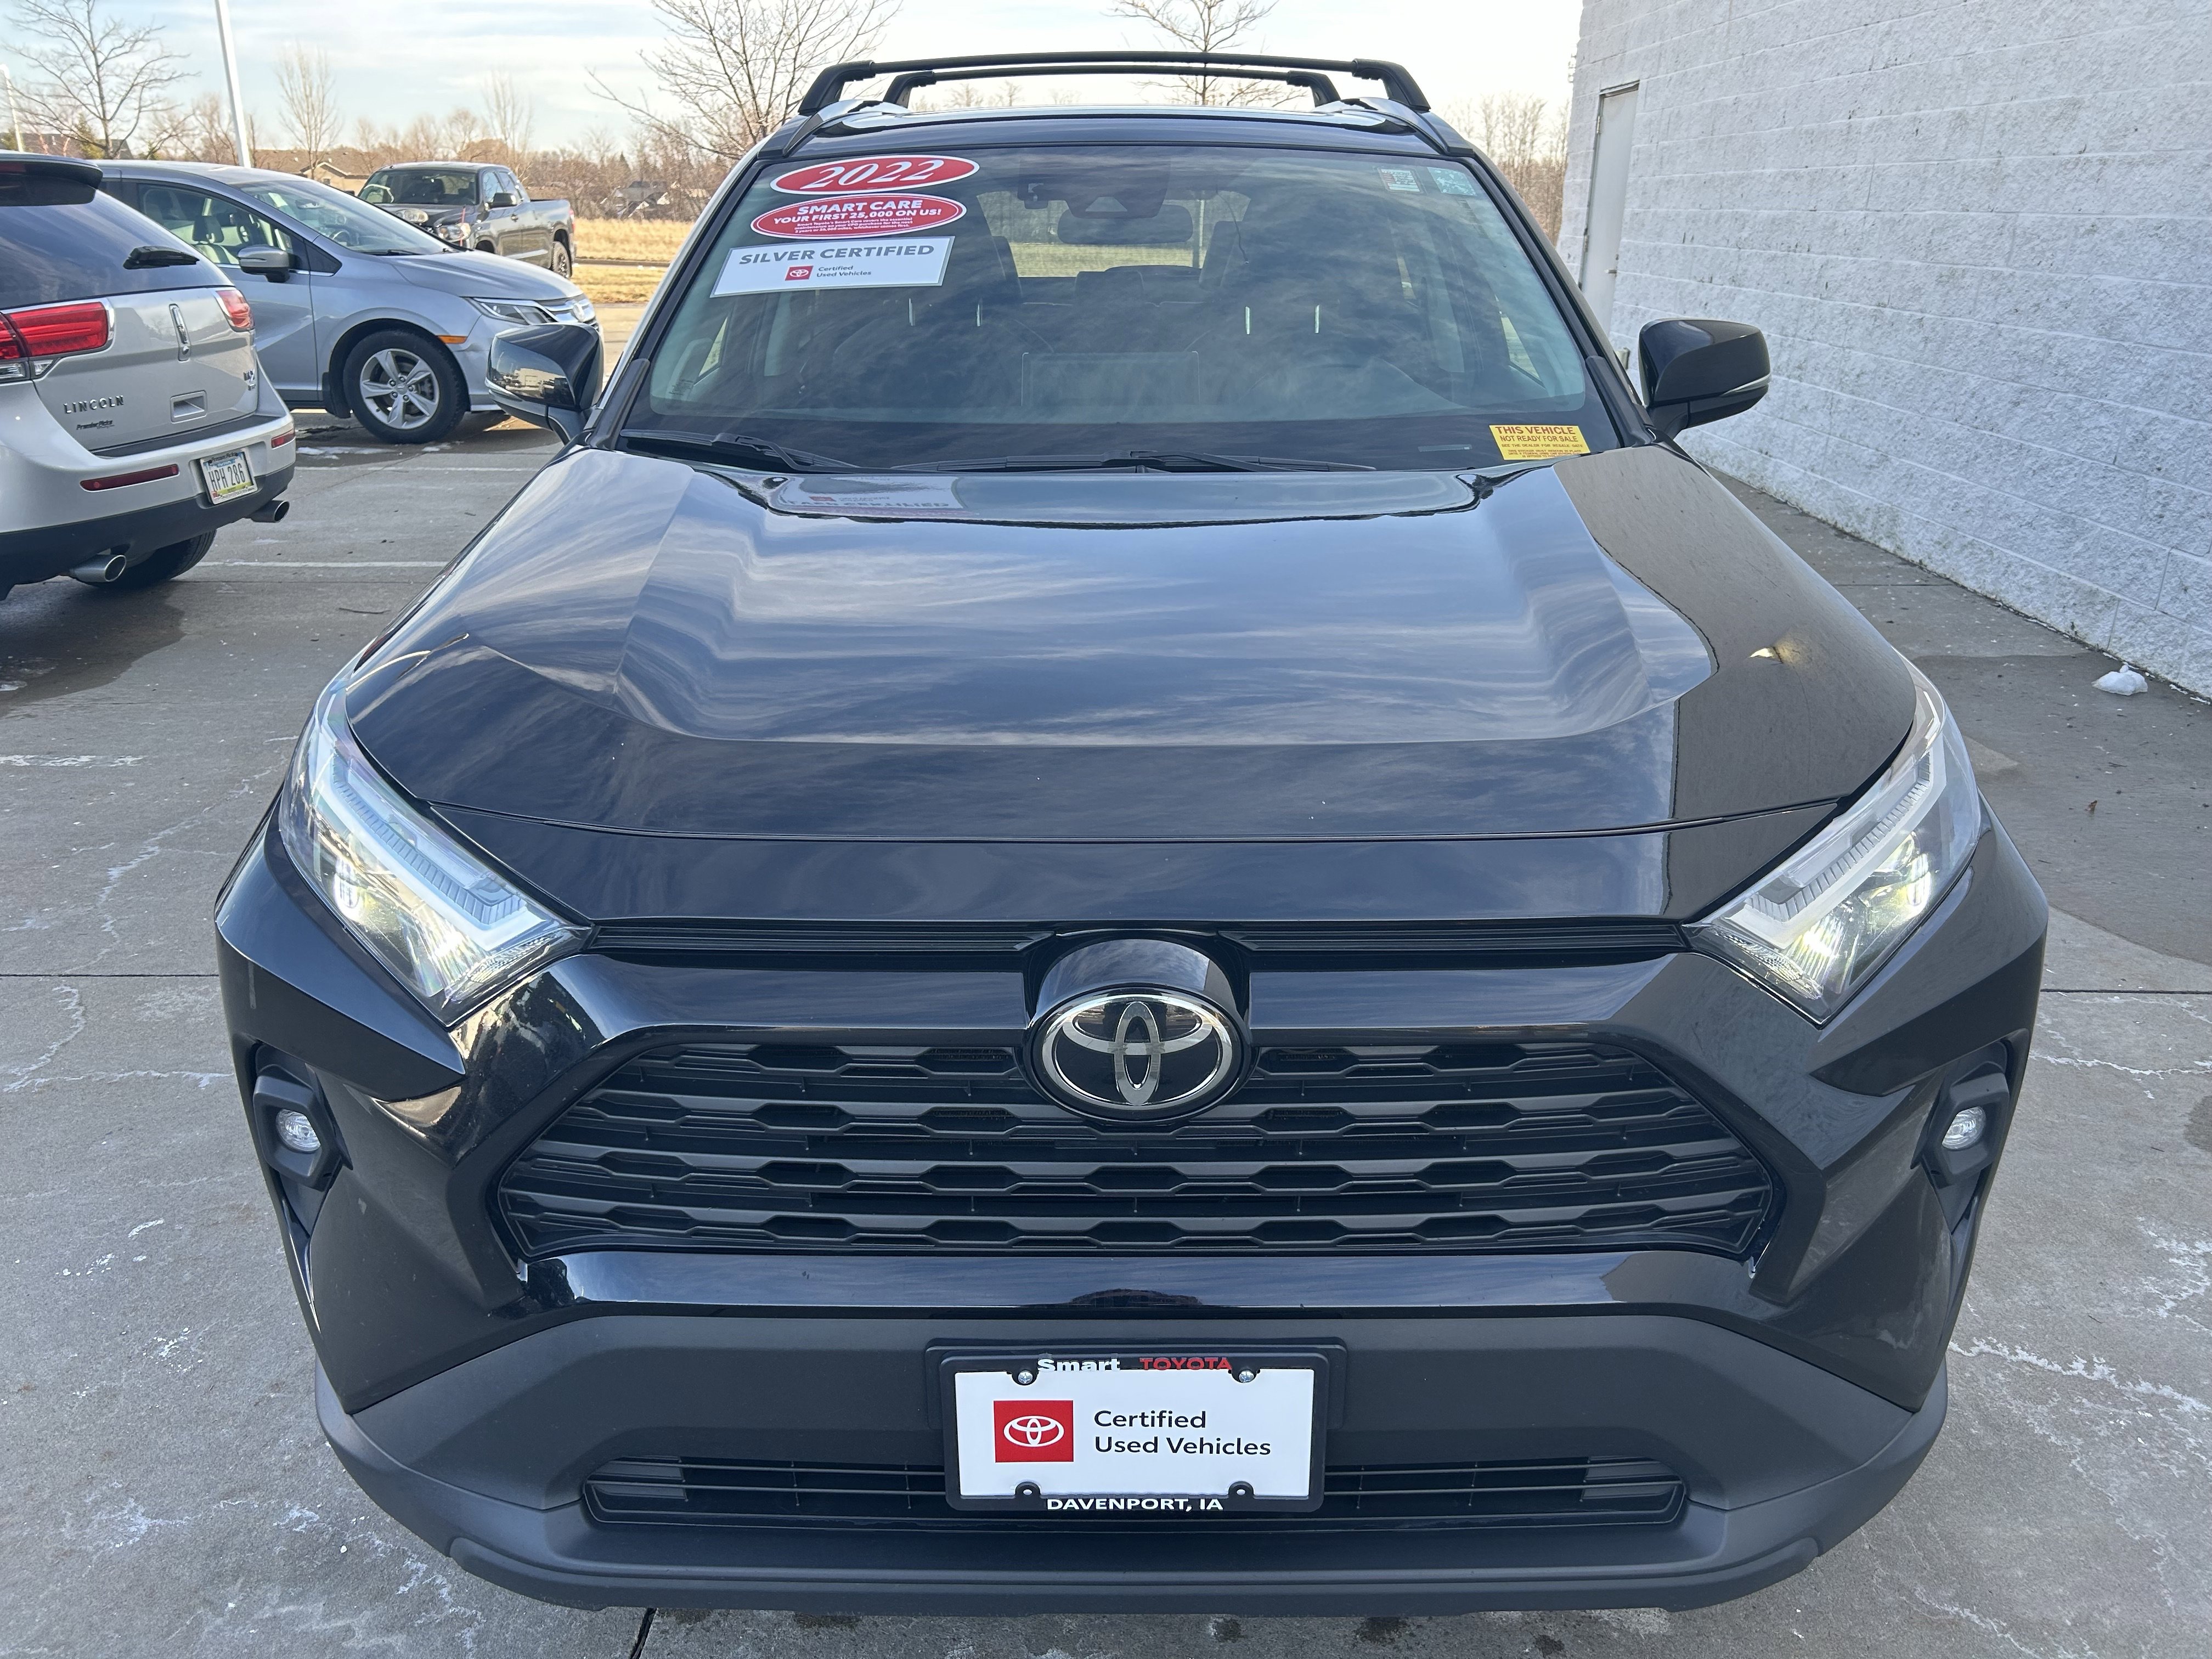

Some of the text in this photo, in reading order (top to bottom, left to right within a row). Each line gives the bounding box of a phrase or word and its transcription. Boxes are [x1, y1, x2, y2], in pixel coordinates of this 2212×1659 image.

[799, 160, 944, 189] 2022
[797, 200, 923, 215] SMART CARE
[774, 216, 810, 224] YOUR
[812, 213, 848, 221] FIRST
[849, 210, 893, 219] 25,000
[739, 245, 934, 264] SILVER CERTIFIED
[64, 394, 125, 414] LINCOLN
[1525, 426, 1576, 435] VEHICLE
[208, 463, 246, 492] HPH 286
[1037, 1357, 1233, 1372] Smart TOYOTA
[1094, 1410, 1206, 1428] Certified
[1095, 1436, 1271, 1455] Used Vehicles
[1047, 1498, 1224, 1512] DAVENPORT, IA
